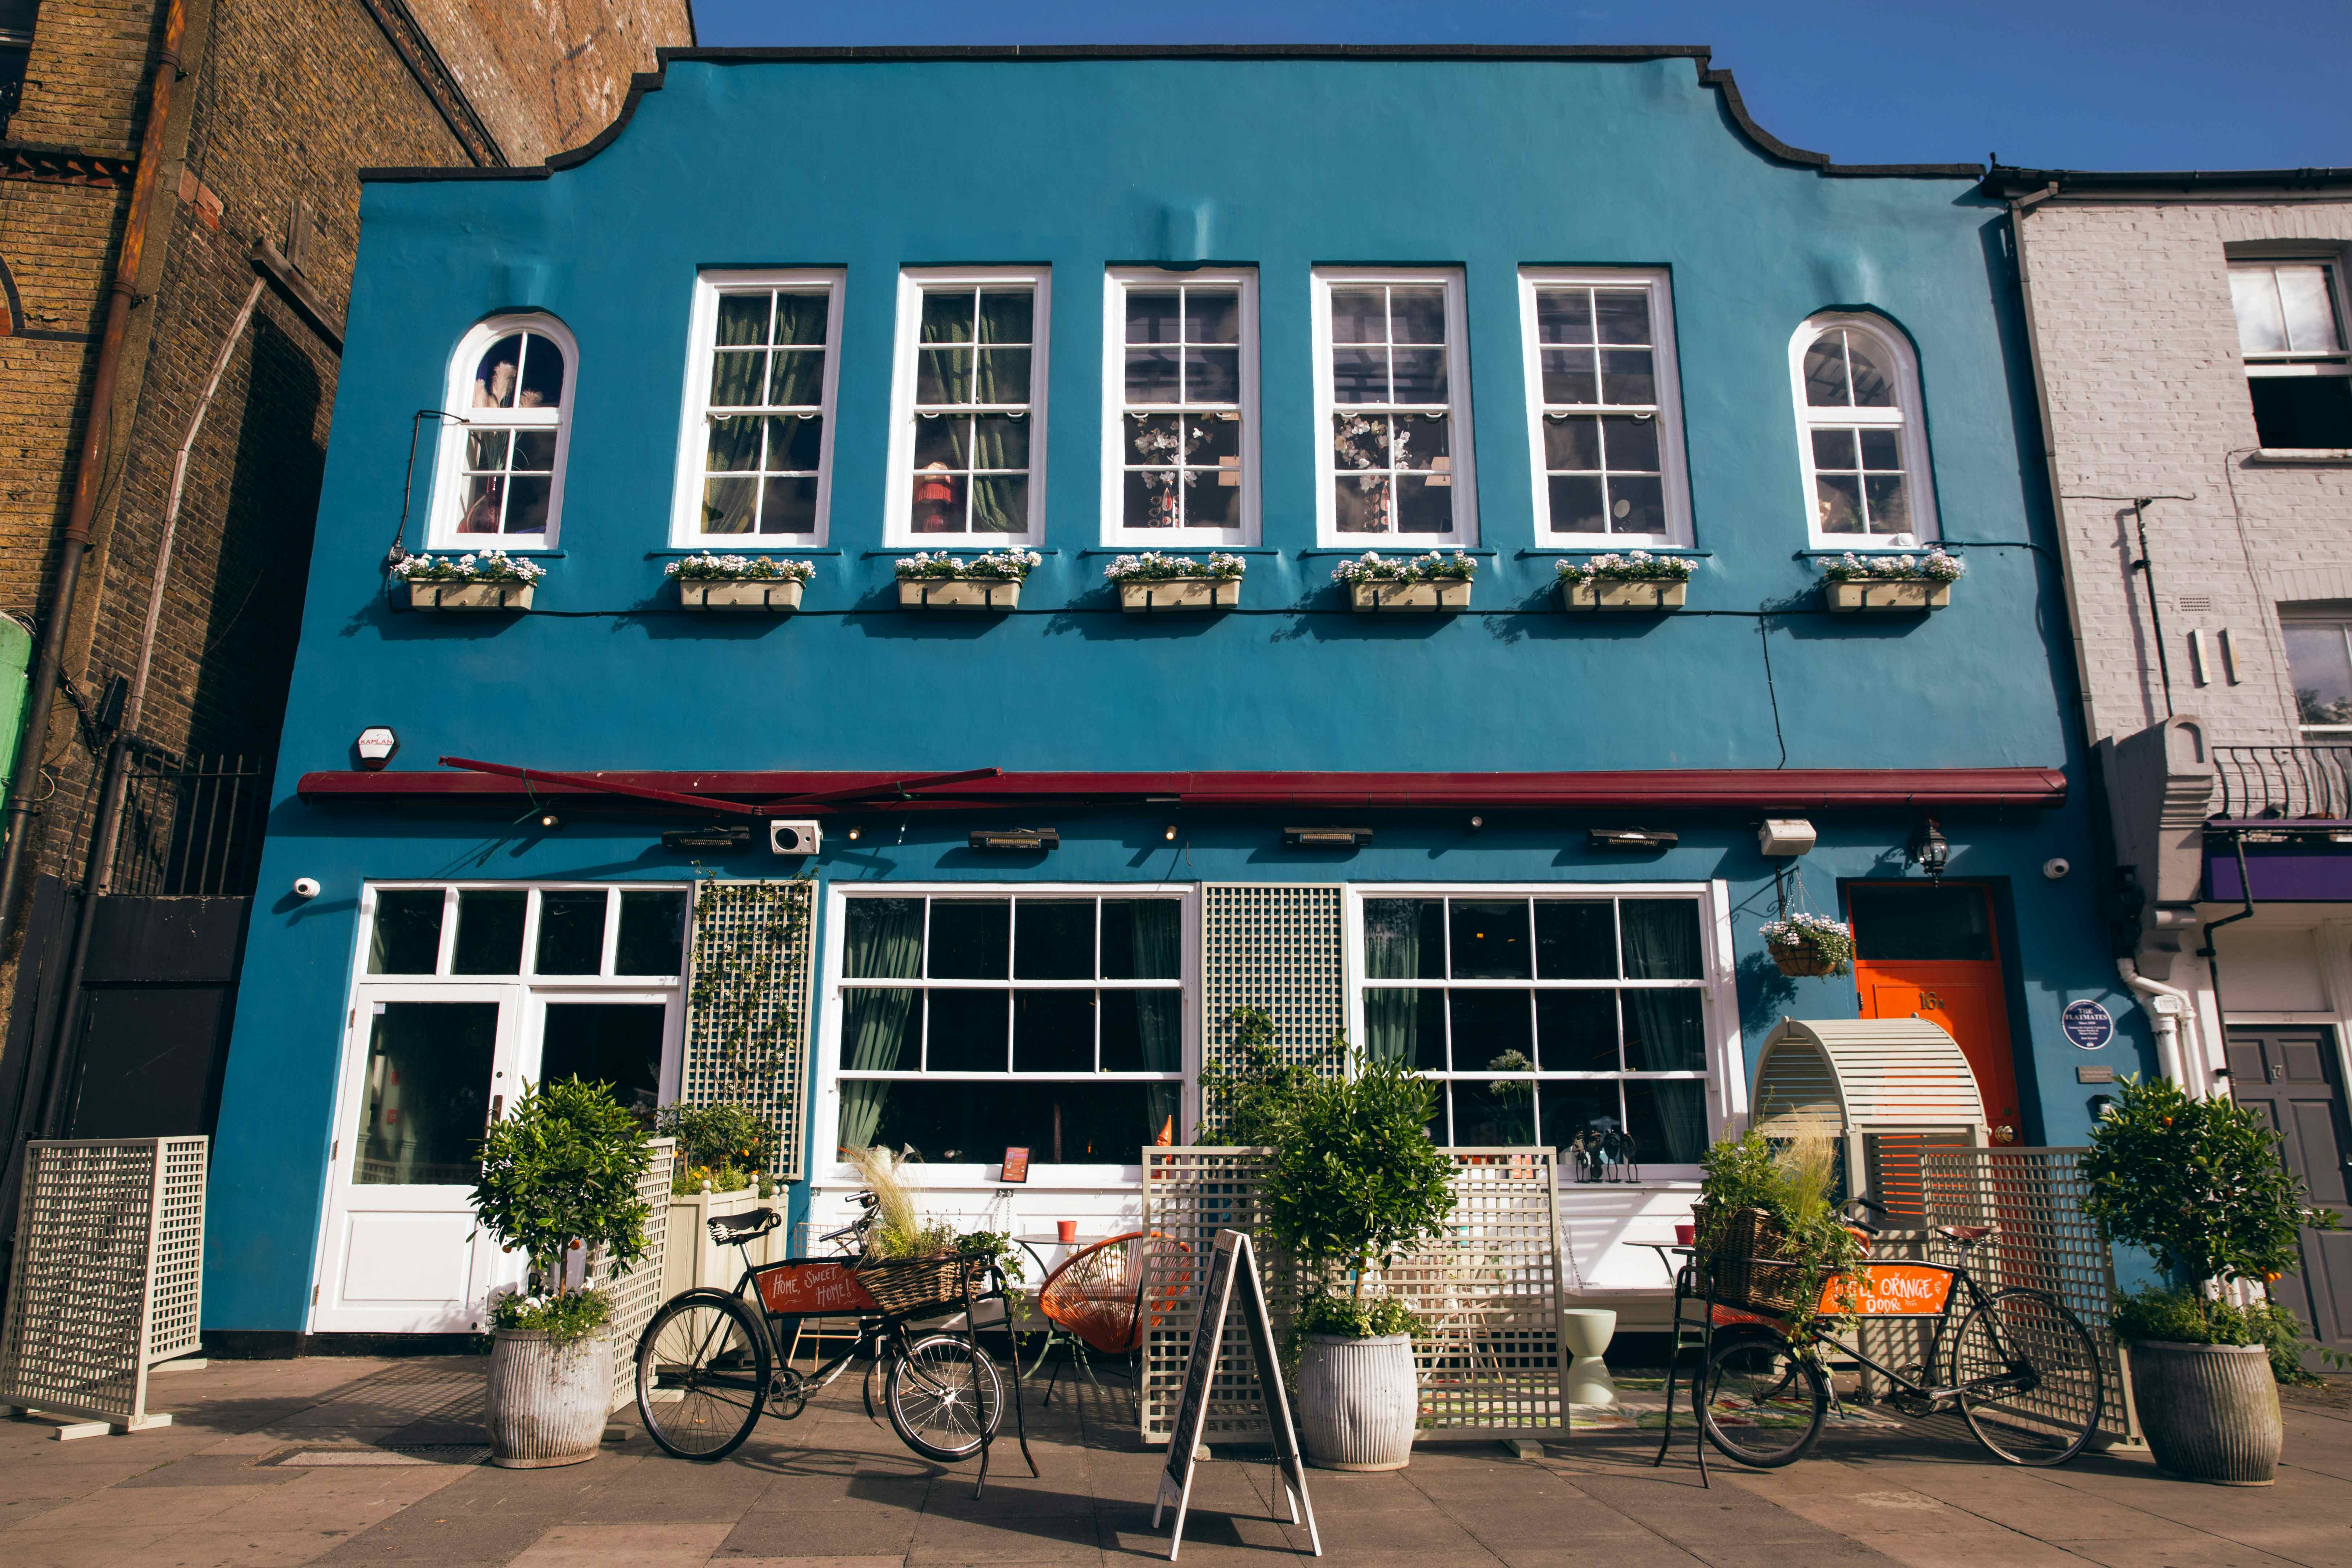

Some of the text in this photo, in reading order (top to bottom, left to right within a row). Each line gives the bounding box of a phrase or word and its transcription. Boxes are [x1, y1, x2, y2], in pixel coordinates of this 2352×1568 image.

[2271, 1065, 2282, 1079] 17
[804, 1266, 838, 1289] SWEET
[1880, 1277, 1933, 1299] ORANGE
[816, 1278, 851, 1307] HOME!
[1866, 1297, 1902, 1313] DOOR
